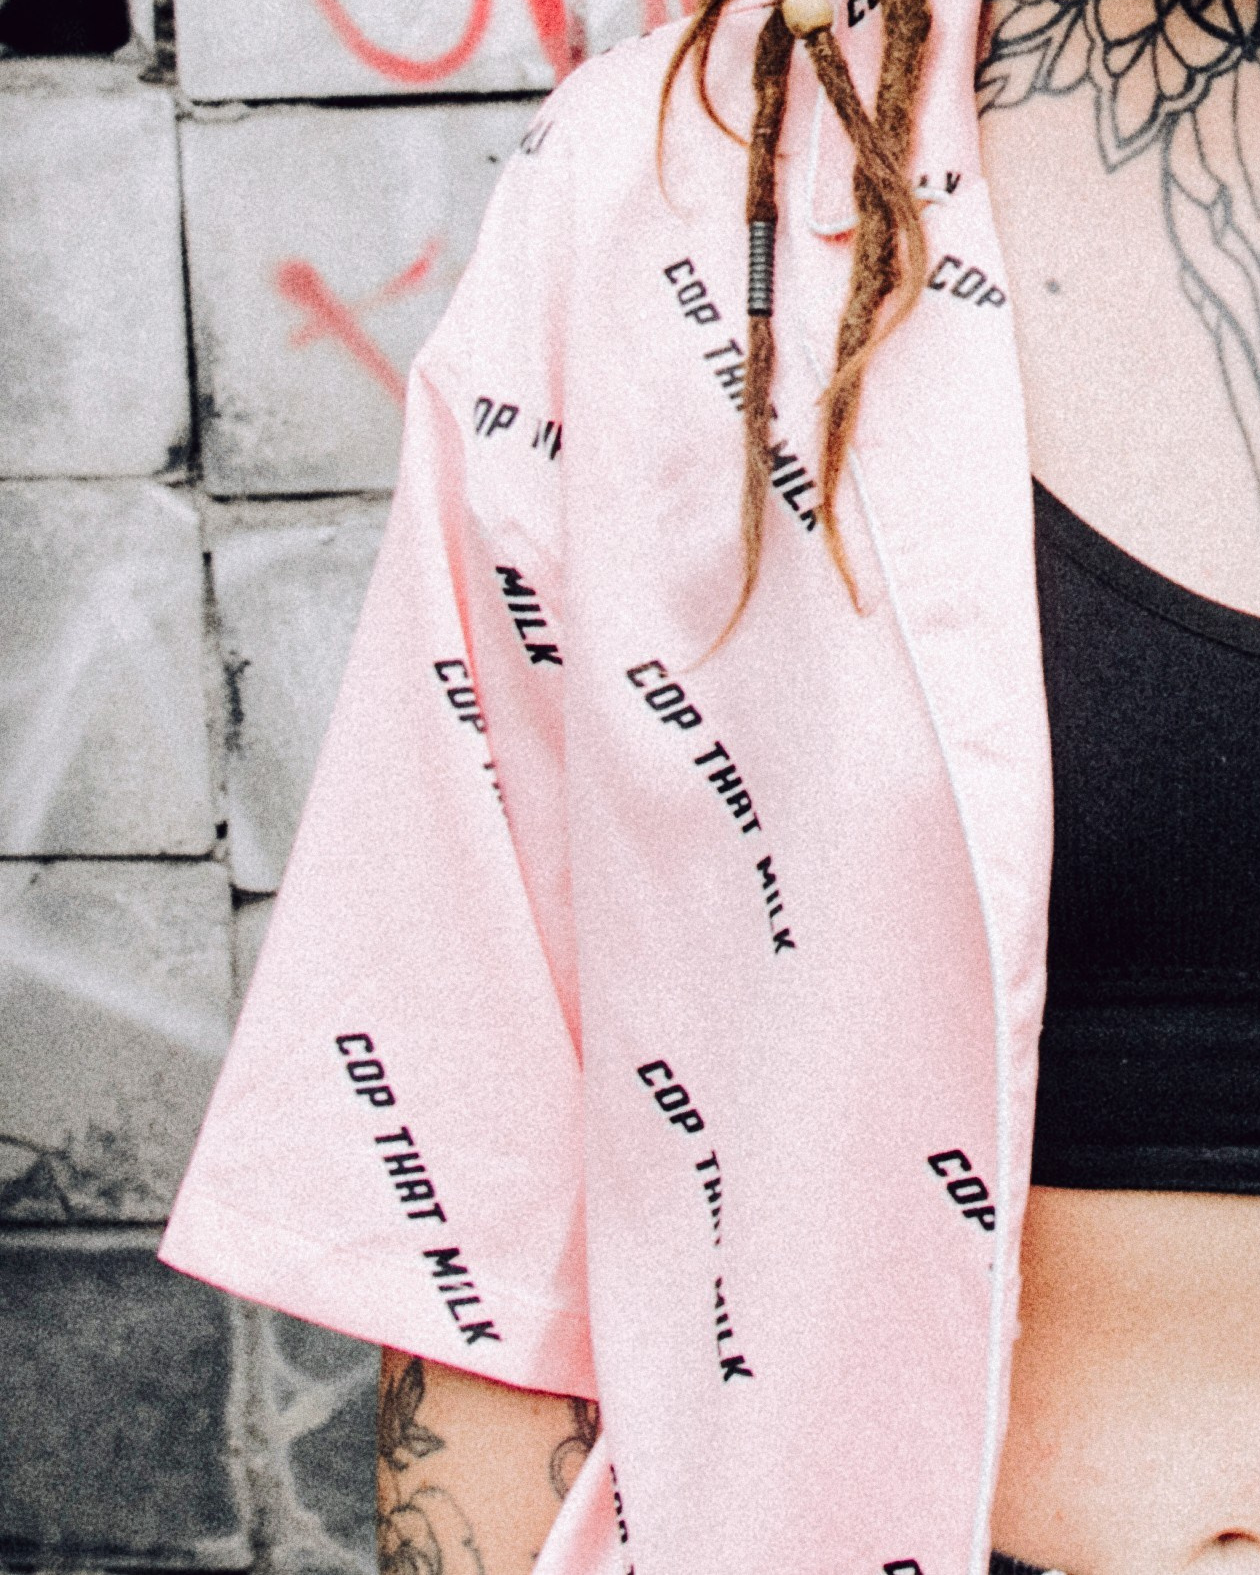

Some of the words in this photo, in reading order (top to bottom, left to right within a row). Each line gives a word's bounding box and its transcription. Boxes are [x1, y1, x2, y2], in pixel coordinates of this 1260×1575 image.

[663, 258, 722, 324] COP
[927, 255, 1006, 308] COP
[496, 566, 563, 665] MILK
[626, 660, 703, 730] COP
[694, 740, 761, 833] THAT
[756, 855, 796, 954] MILK
[637, 1059, 705, 1133] COP
[335, 1033, 395, 1107] COP
[374, 1126, 447, 1223] THAT
[422, 1248, 502, 1345] MILK
[927, 1149, 995, 1231] COP
